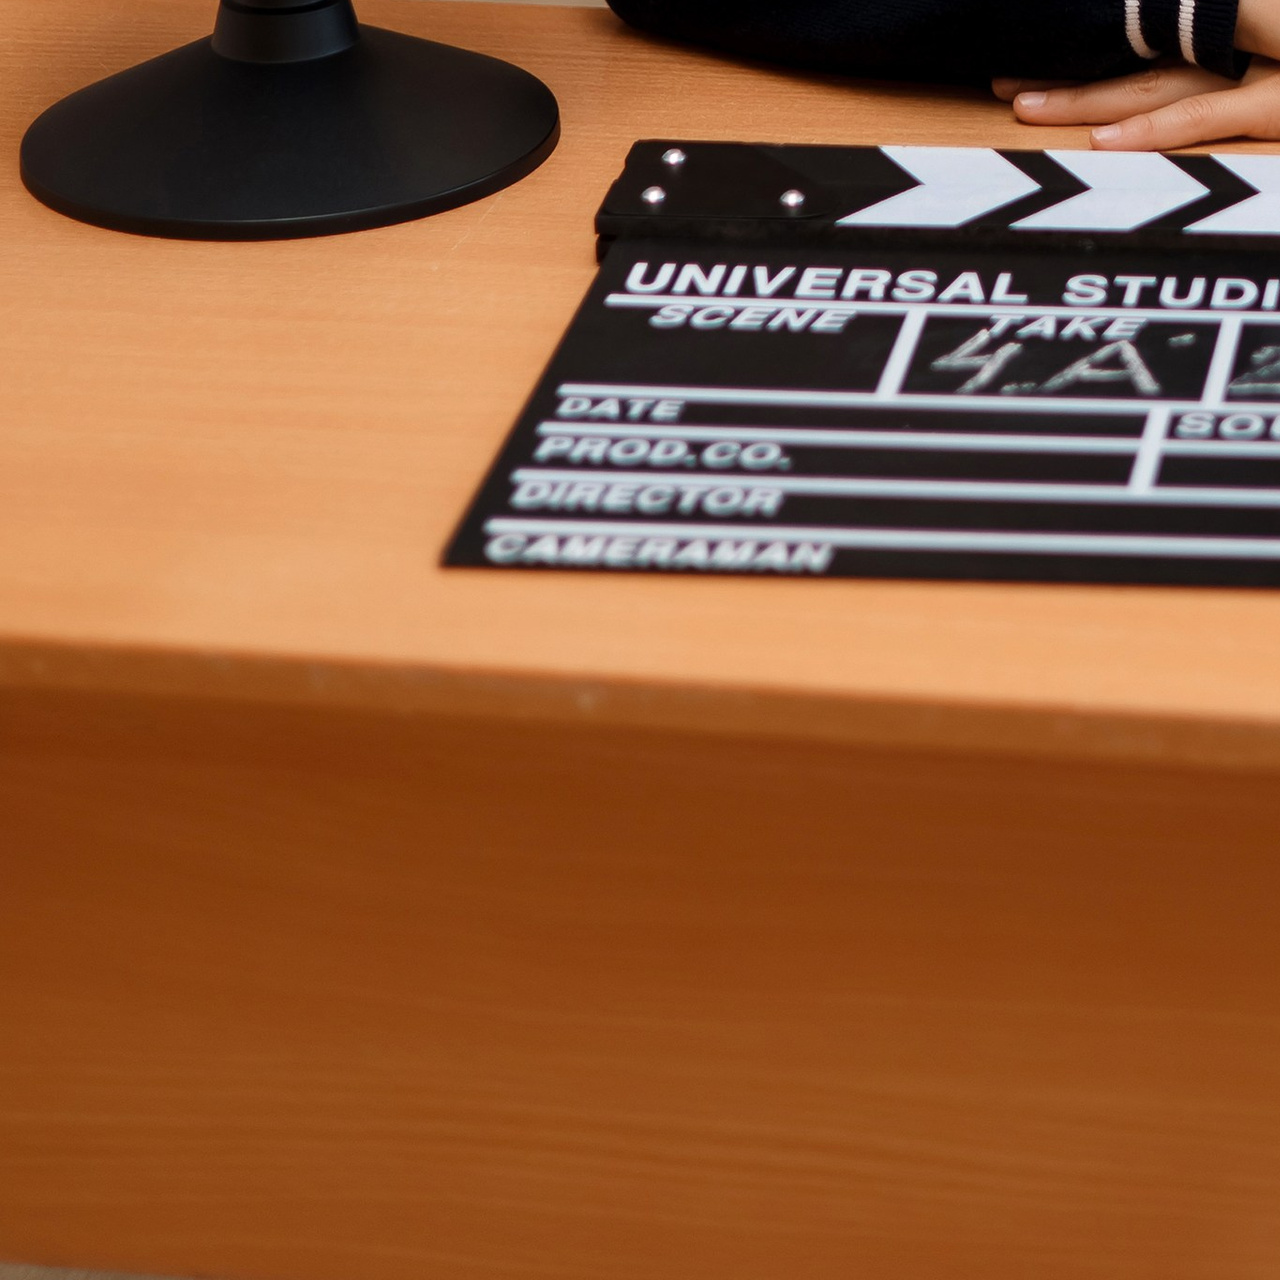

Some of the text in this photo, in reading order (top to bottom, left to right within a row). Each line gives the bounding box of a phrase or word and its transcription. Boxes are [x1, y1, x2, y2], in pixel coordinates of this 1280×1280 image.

[625, 261, 1029, 305] UNIVERSAL
[649, 303, 857, 332] SCENE
[988, 314, 1148, 340] TAKE
[556, 396, 686, 422] DATE
[510, 480, 785, 517] DIRECTOR
[484, 532, 834, 572] CAMERAMAN
